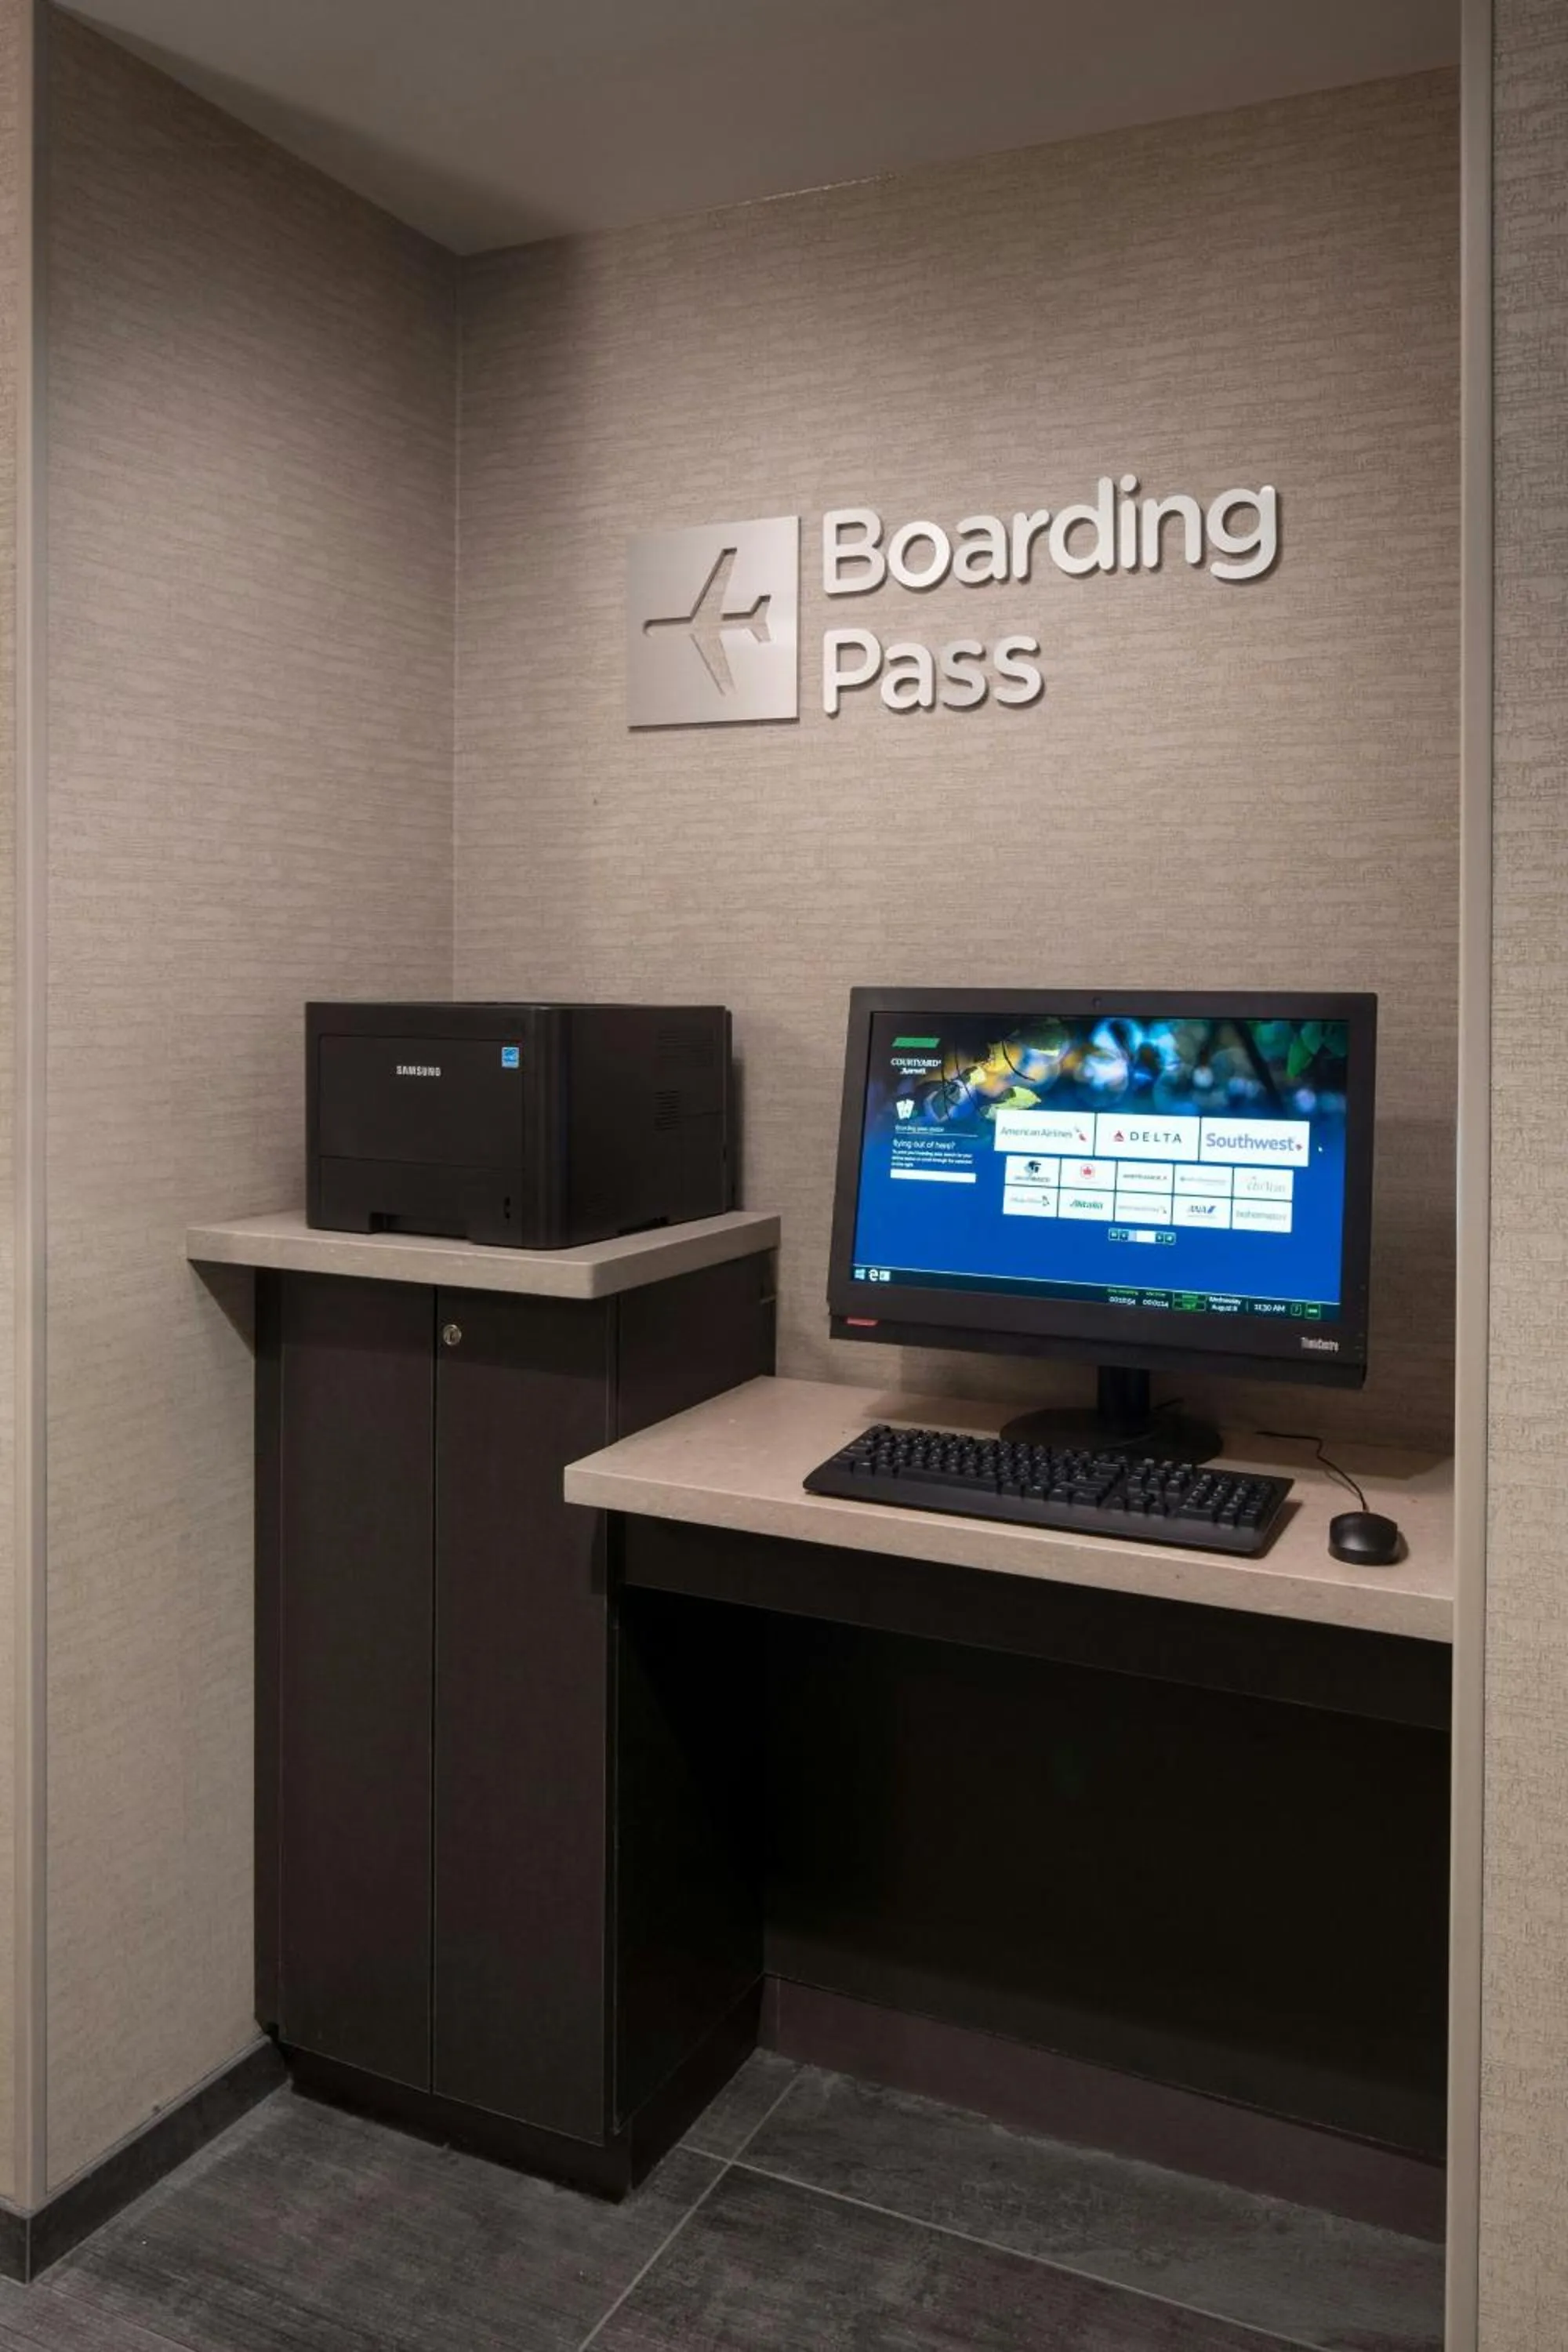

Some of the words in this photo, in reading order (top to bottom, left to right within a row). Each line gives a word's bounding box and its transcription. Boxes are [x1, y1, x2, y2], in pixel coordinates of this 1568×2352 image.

[822, 474, 1278, 594] Boarding
[822, 629, 1044, 715] Pass
[396, 1065, 441, 1076] SAMSUNG
[1130, 1131, 1182, 1143] DELTA
[1206, 1132, 1294, 1151] Southwest
